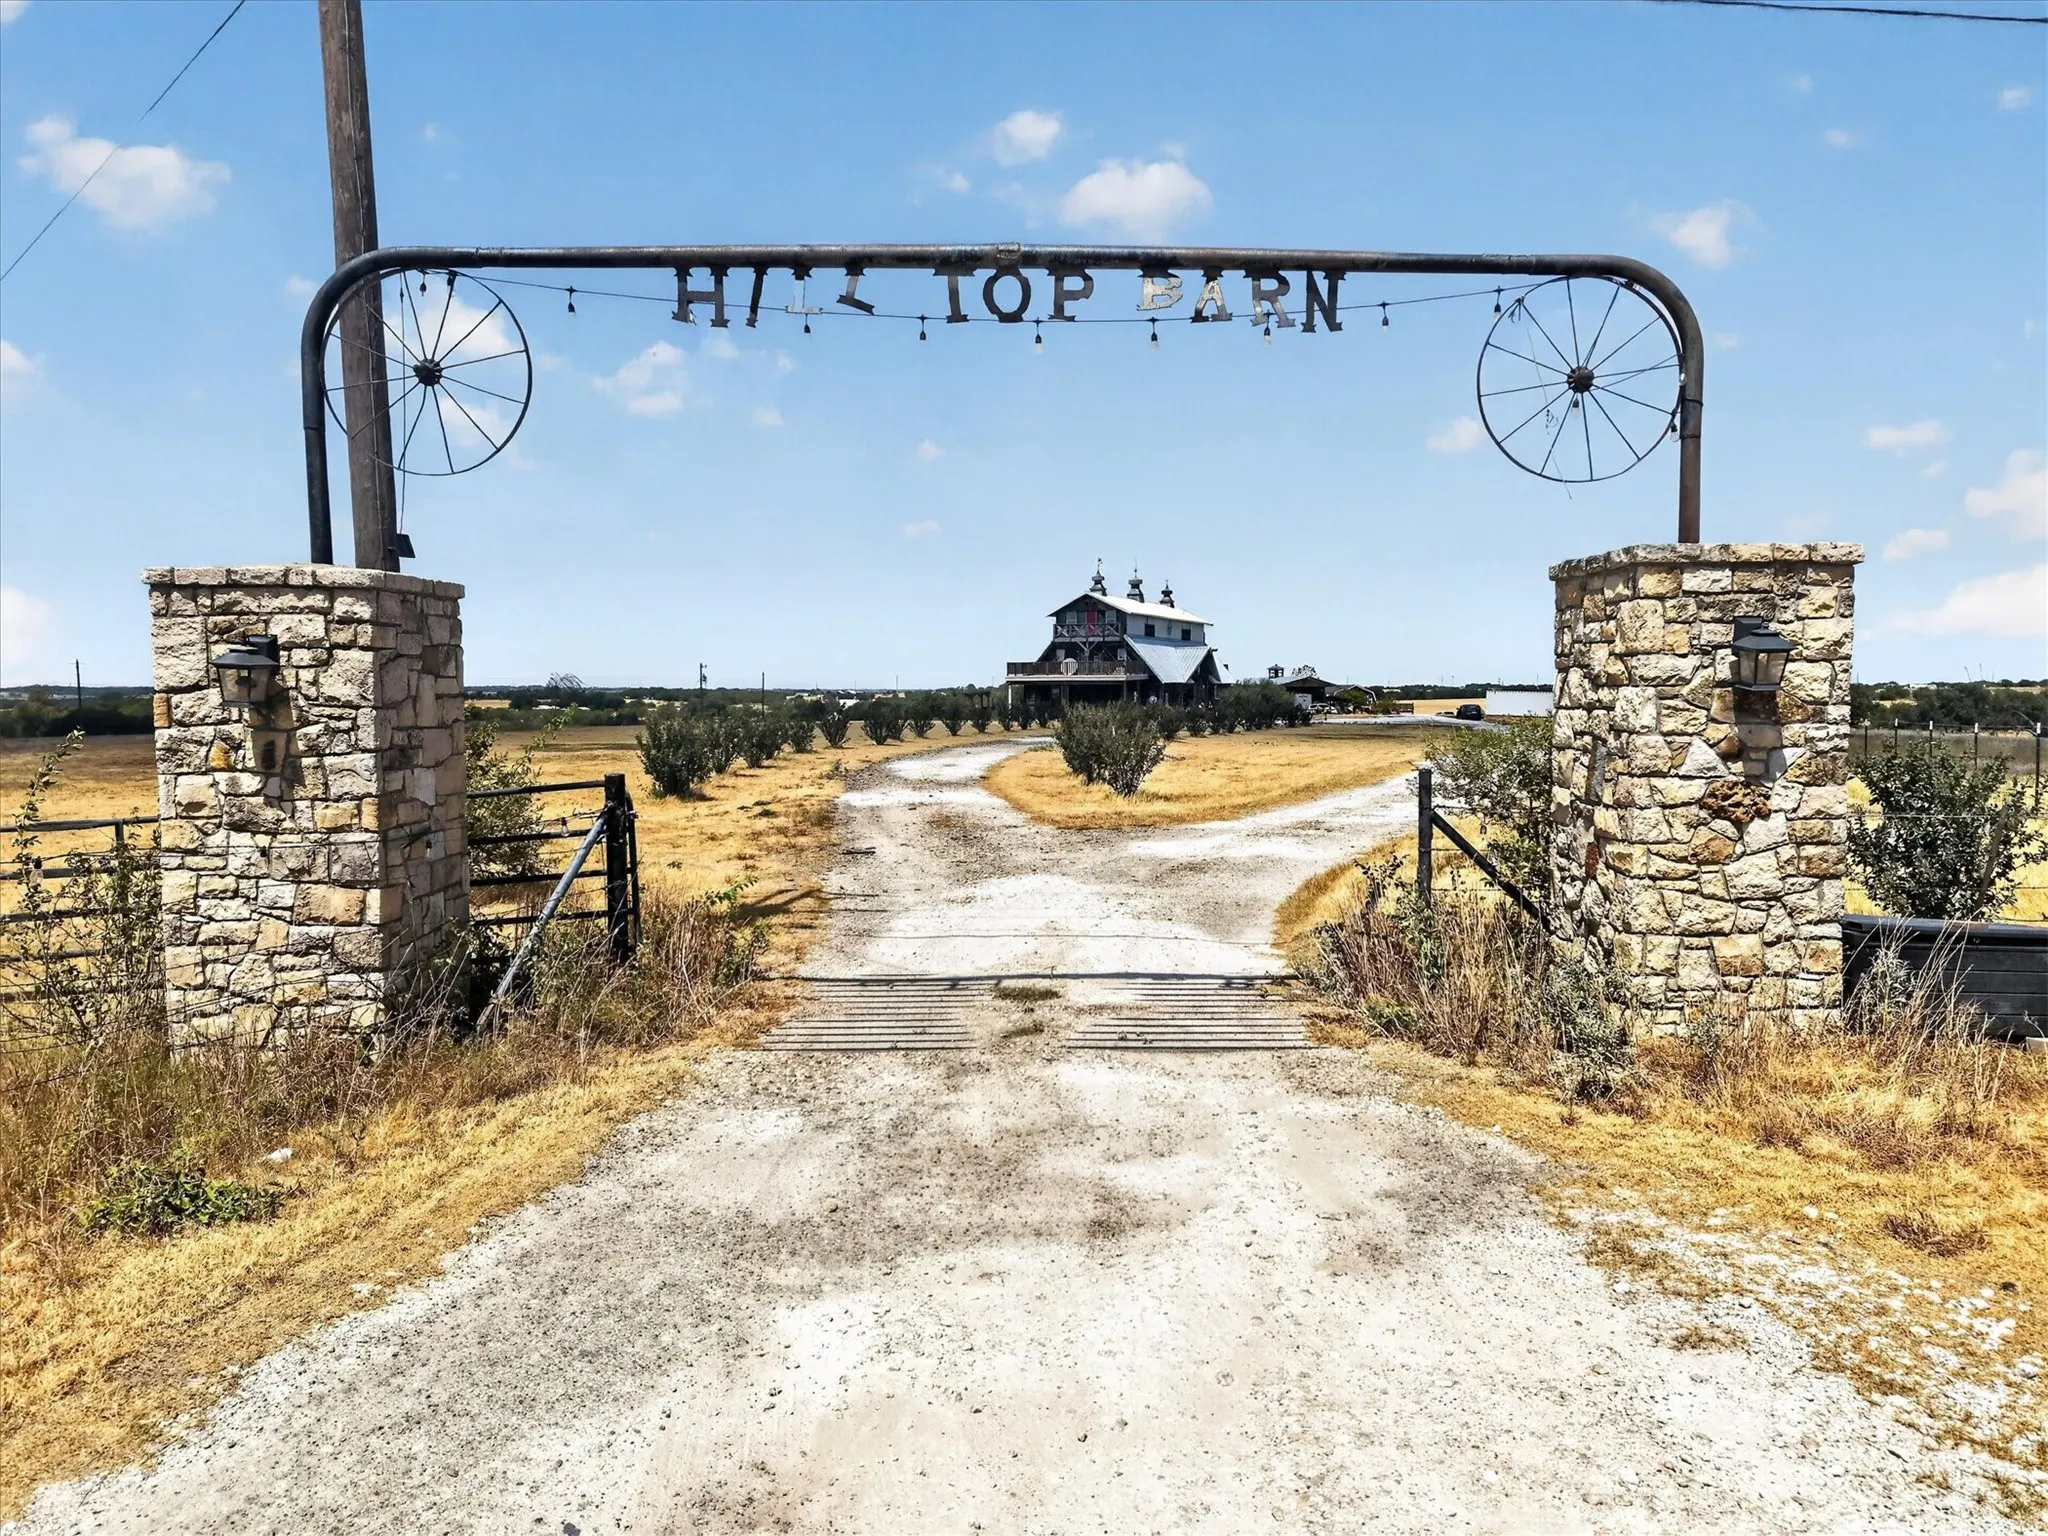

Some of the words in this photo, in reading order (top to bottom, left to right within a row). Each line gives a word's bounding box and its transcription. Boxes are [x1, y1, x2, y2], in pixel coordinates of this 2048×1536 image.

[672, 266, 875, 328] HILL
[933, 267, 1094, 324] TOP
[1137, 267, 1346, 333] BARN
